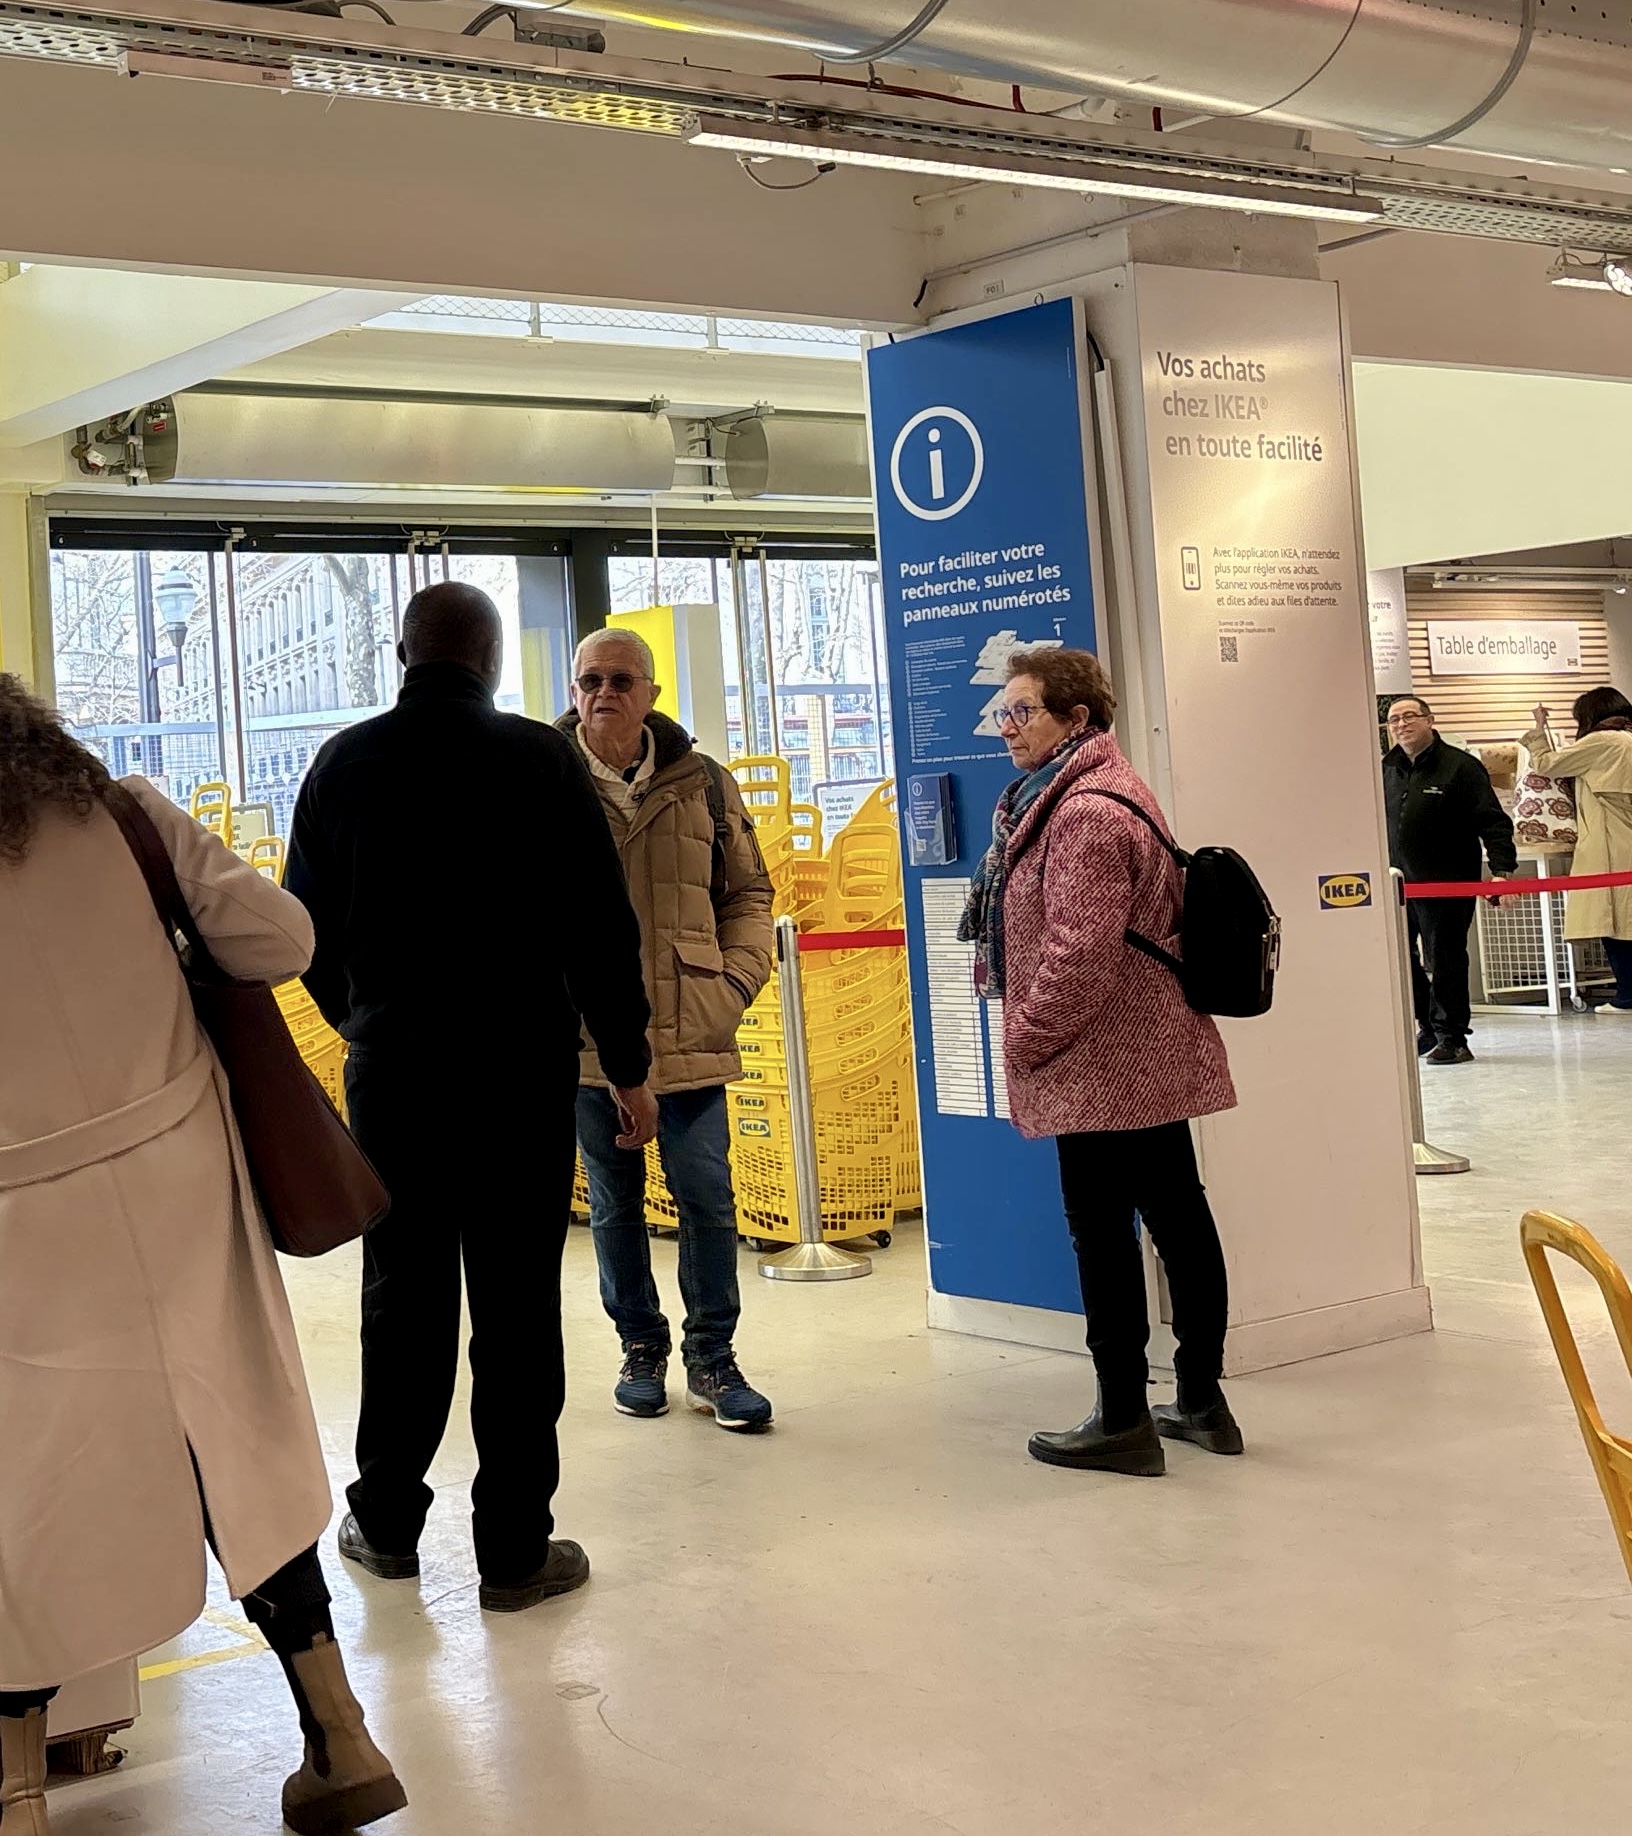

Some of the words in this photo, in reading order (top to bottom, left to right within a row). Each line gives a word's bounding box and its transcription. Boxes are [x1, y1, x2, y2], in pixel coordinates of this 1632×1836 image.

[1157, 351, 1194, 377] Vos
[1200, 355, 1266, 383] achats
[1163, 390, 1209, 418] chez
[1166, 435, 1191, 456] en
[1197, 434, 1252, 459] toute
[1257, 434, 1323, 461] facilité
[900, 561, 935, 579] Pour
[938, 551, 998, 572] faciliter
[1001, 543, 1045, 562] votre
[1213, 548, 1232, 558] Avec
[1233, 548, 1280, 562] l'application
[1302, 549, 1341, 560] n'attendez
[1214, 563, 1232, 576] plus
[1233, 565, 1251, 576] pour
[1253, 564, 1276, 577] régler
[1278, 566, 1292, 575] vos
[901, 575, 982, 601] recherche,
[984, 568, 1034, 589] suivez
[1037, 563, 1061, 582] les
[1215, 579, 1248, 591] Scannez
[1249, 579, 1295, 591] vous-même
[1296, 581, 1309, 591] vos
[1310, 580, 1343, 593] produits
[903, 600, 979, 628] panneaux
[982, 585, 1071, 613] numérotés
[1217, 596, 1225, 606] et
[1226, 595, 1246, 606] dites
[1247, 596, 1269, 607] adieu
[1270, 597, 1285, 606] aux
[1286, 595, 1302, 606] files
[1372, 601, 1392, 610] votre
[1053, 623, 1061, 637] 1
[1436, 636, 1474, 655] Table
[1477, 635, 1557, 660] d'emballage
[1324, 883, 1367, 899] IKEA
[740, 1098, 765, 1107] IKEA
[741, 1122, 768, 1131] IKEA
